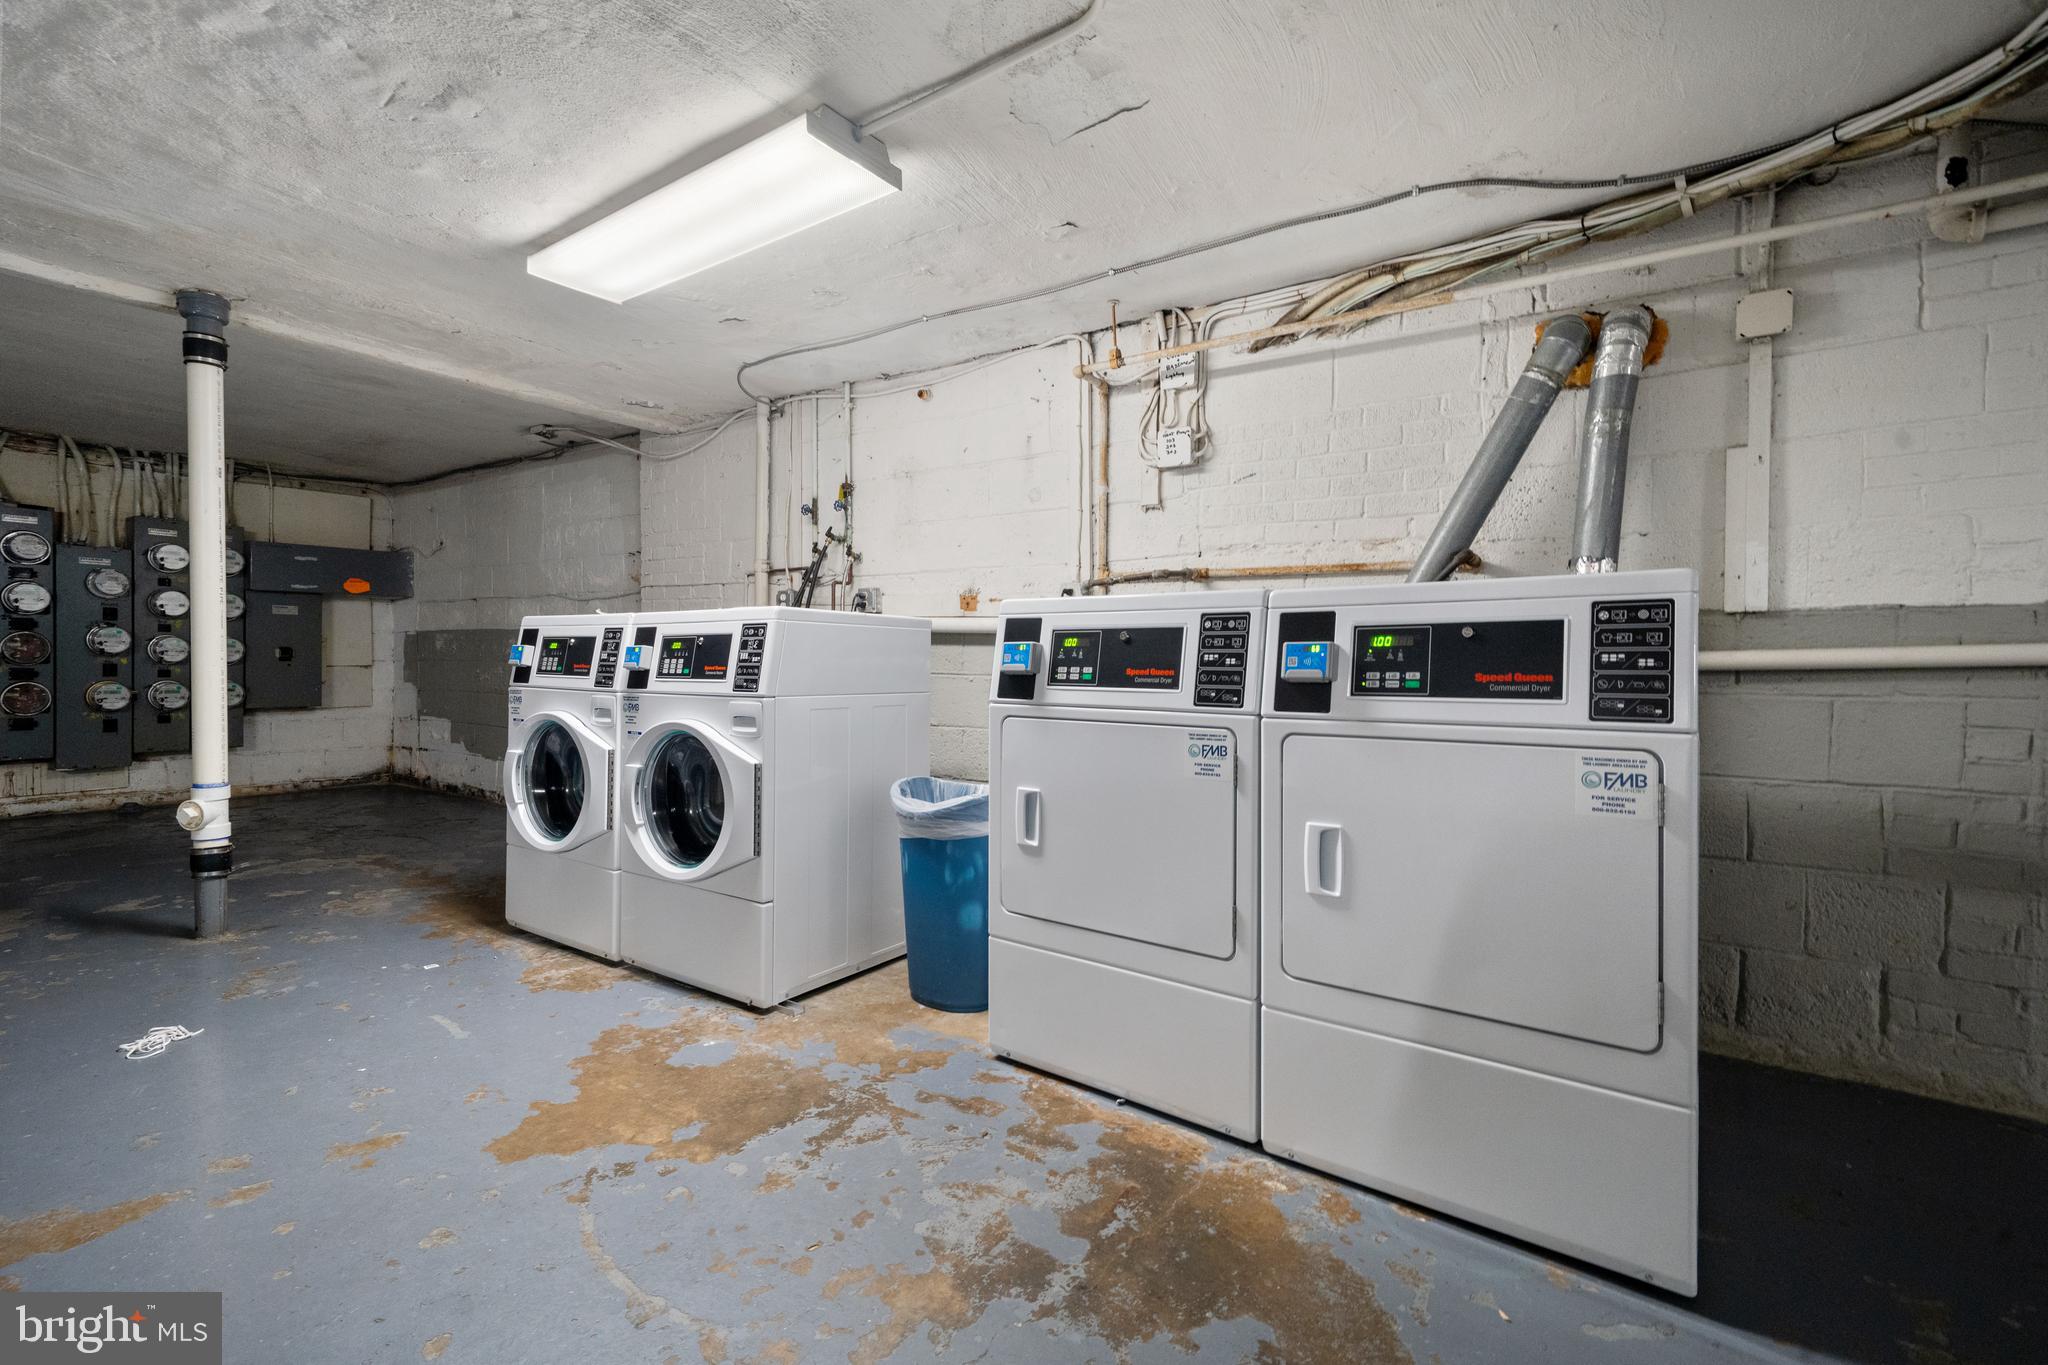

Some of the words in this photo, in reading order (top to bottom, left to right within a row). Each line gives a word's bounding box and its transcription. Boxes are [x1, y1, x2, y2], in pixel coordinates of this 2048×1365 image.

[1126, 668, 1149, 677] Speed
[1151, 668, 1175, 676] Queen
[1474, 672, 1512, 683] Speed
[1514, 672, 1553, 682] Queen
[1489, 683, 1529, 692] Commercial
[1531, 684, 1551, 693] Dryer
[1201, 744, 1228, 759] FMB
[1604, 771, 1648, 791] FMB
[1606, 795, 1636, 803] SERVICE
